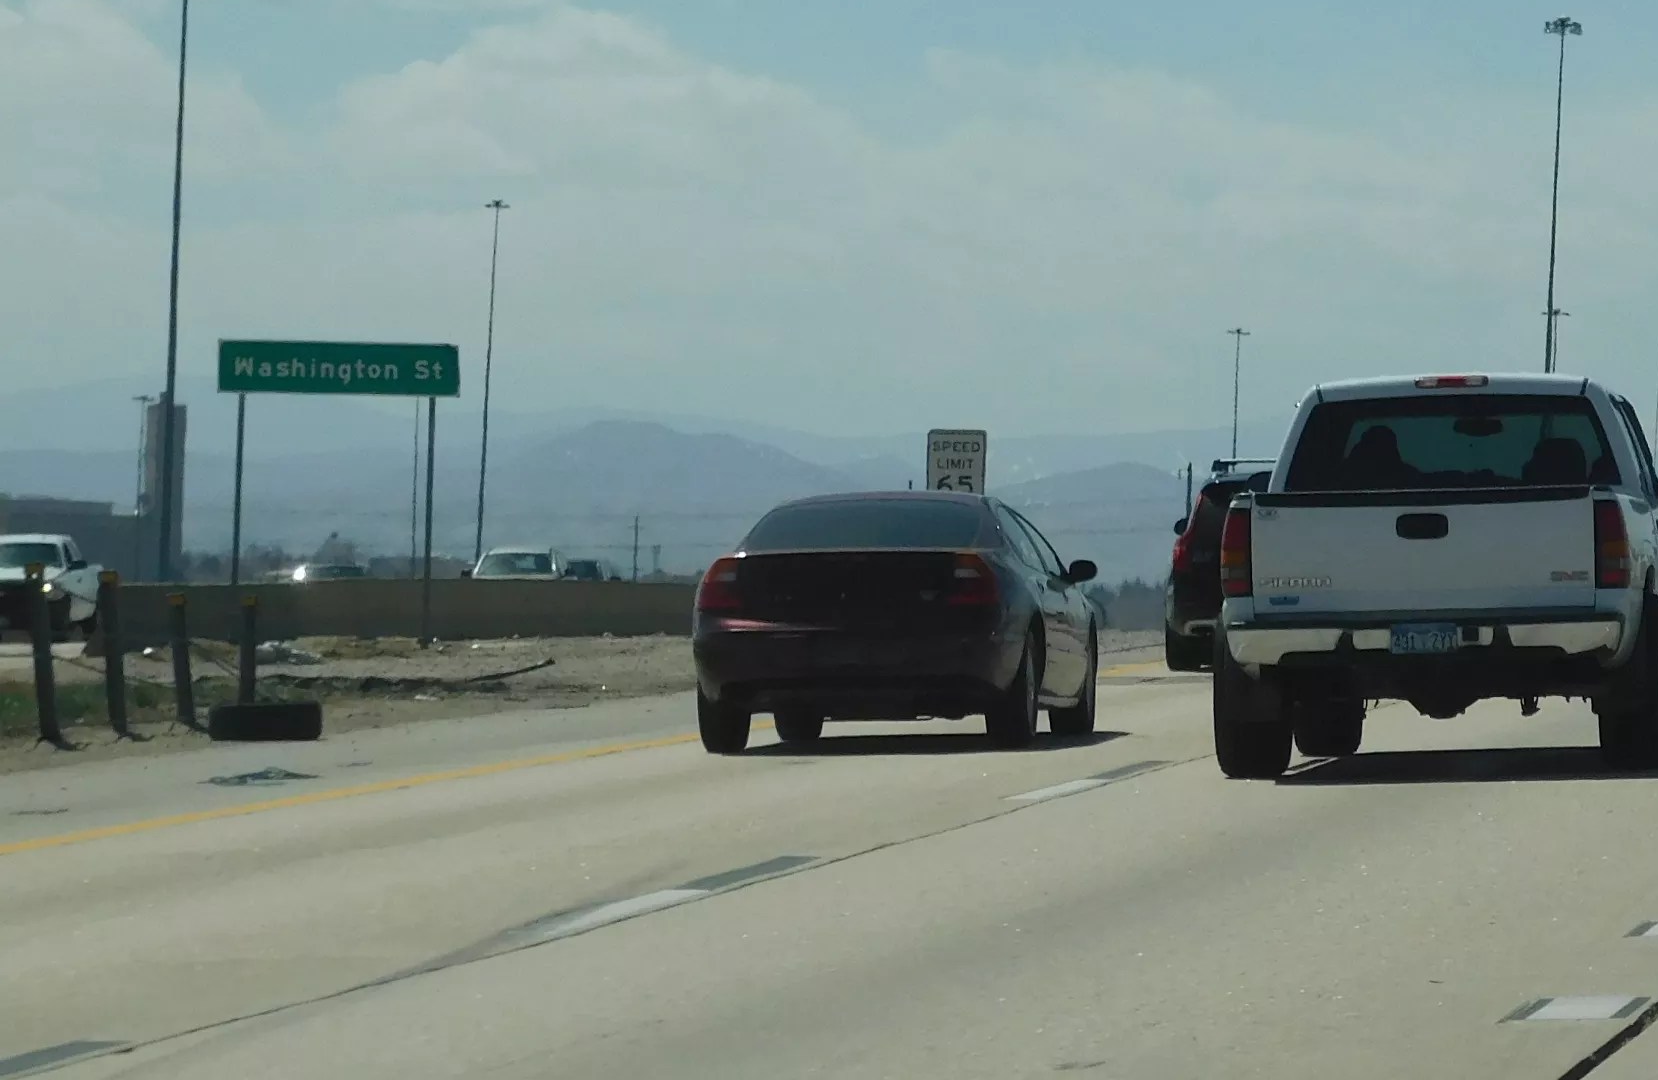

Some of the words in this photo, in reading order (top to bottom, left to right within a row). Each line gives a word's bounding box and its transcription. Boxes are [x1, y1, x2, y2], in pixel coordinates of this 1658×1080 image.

[234, 356, 398, 385] Washington
[414, 359, 443, 380] St
[932, 440, 980, 453] SPEED
[937, 458, 973, 469] LIMIT
[937, 474, 973, 493] 65
